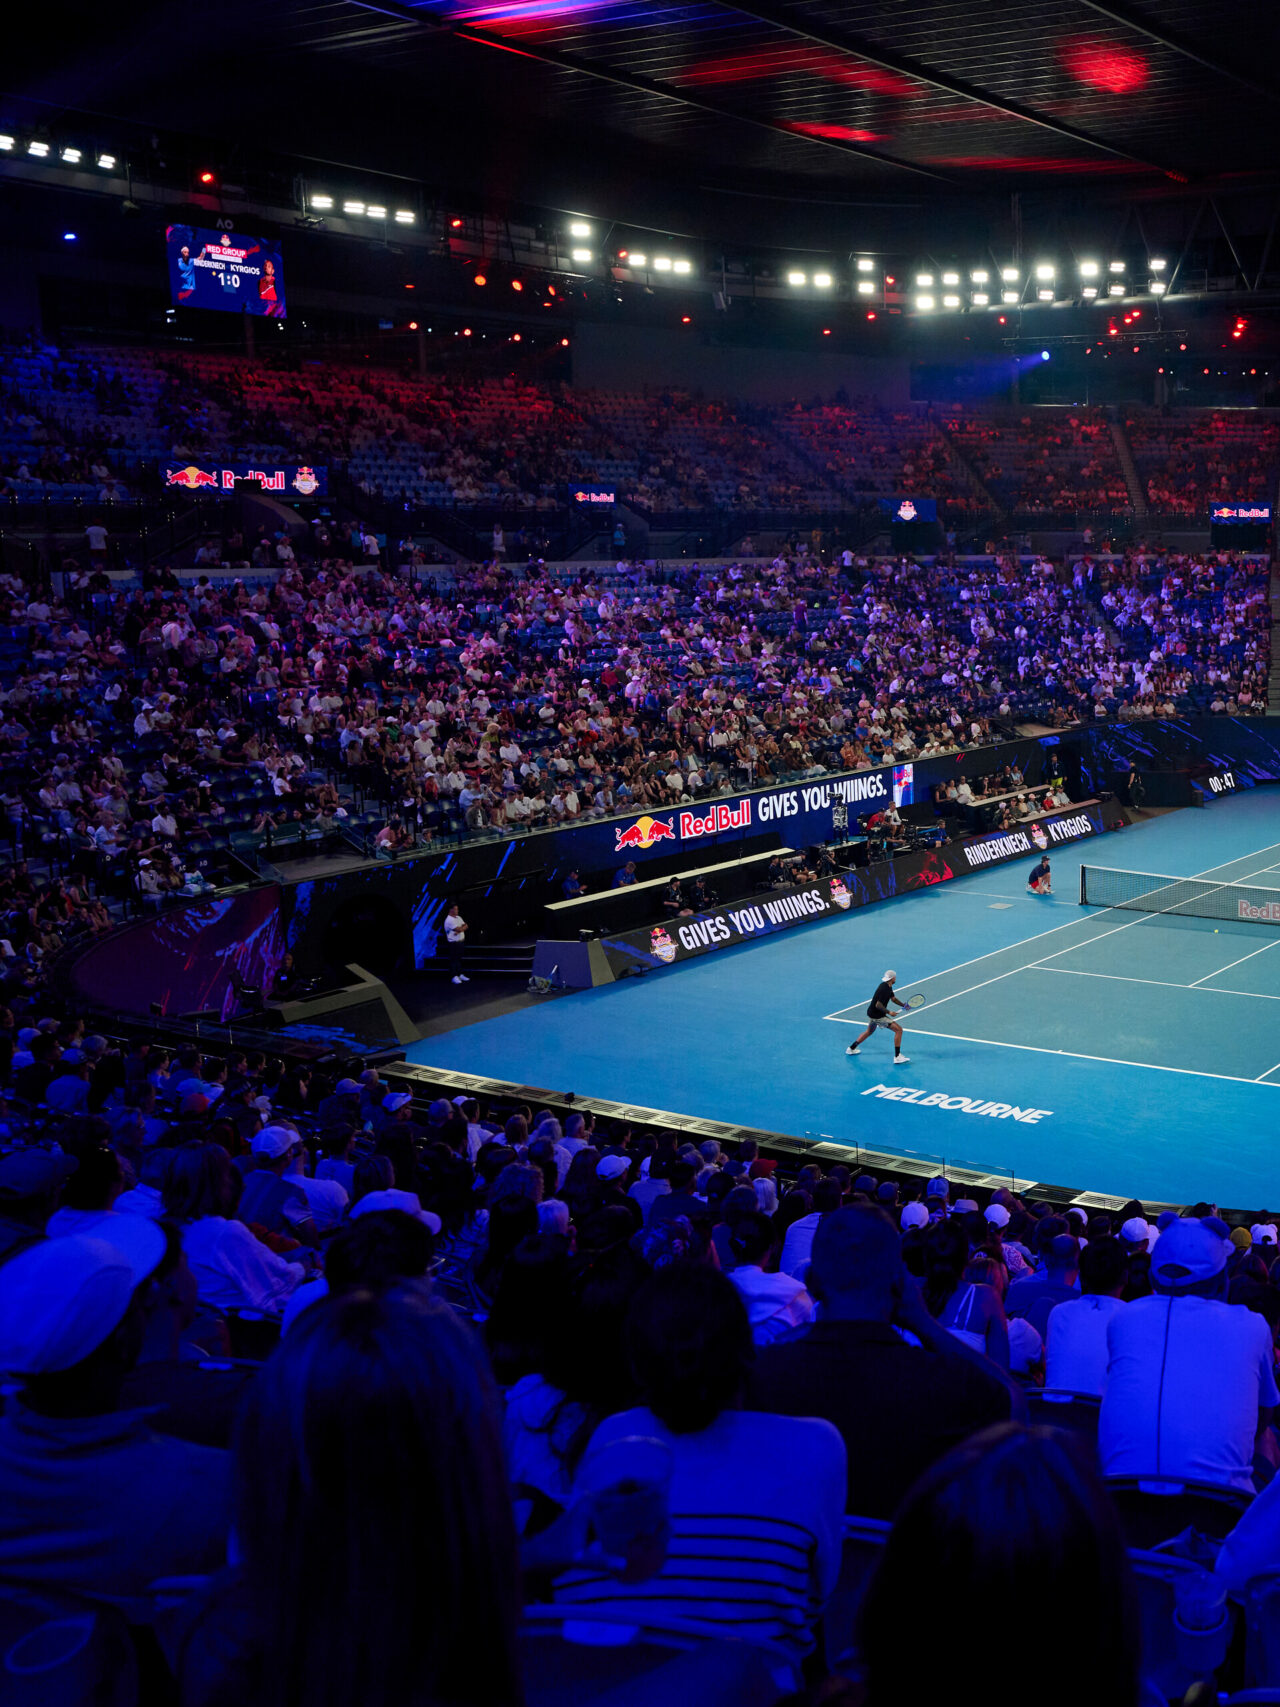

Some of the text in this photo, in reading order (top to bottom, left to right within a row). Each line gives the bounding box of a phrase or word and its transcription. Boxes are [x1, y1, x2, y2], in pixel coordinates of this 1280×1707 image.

[207, 245, 246, 257] RED GROUP
[230, 263, 260, 276] KYRGIOS
[255, 471, 286, 490] Bull
[1208, 772, 1236, 793] 00:47
[680, 805, 717, 839] Red
[717, 798, 752, 832] Bull
[758, 791, 799, 822] GIVES
[801, 784, 831, 812] YOU
[963, 831, 1032, 866] RINDERKNECH
[1047, 814, 1092, 841] KYRGIOS
[678, 915, 731, 950] GIVES
[728, 906, 766, 935] YOU
[763, 889, 831, 925] WIIINGS.
[1238, 899, 1269, 920] Red
[860, 1083, 1055, 1124] MELBOURNE
